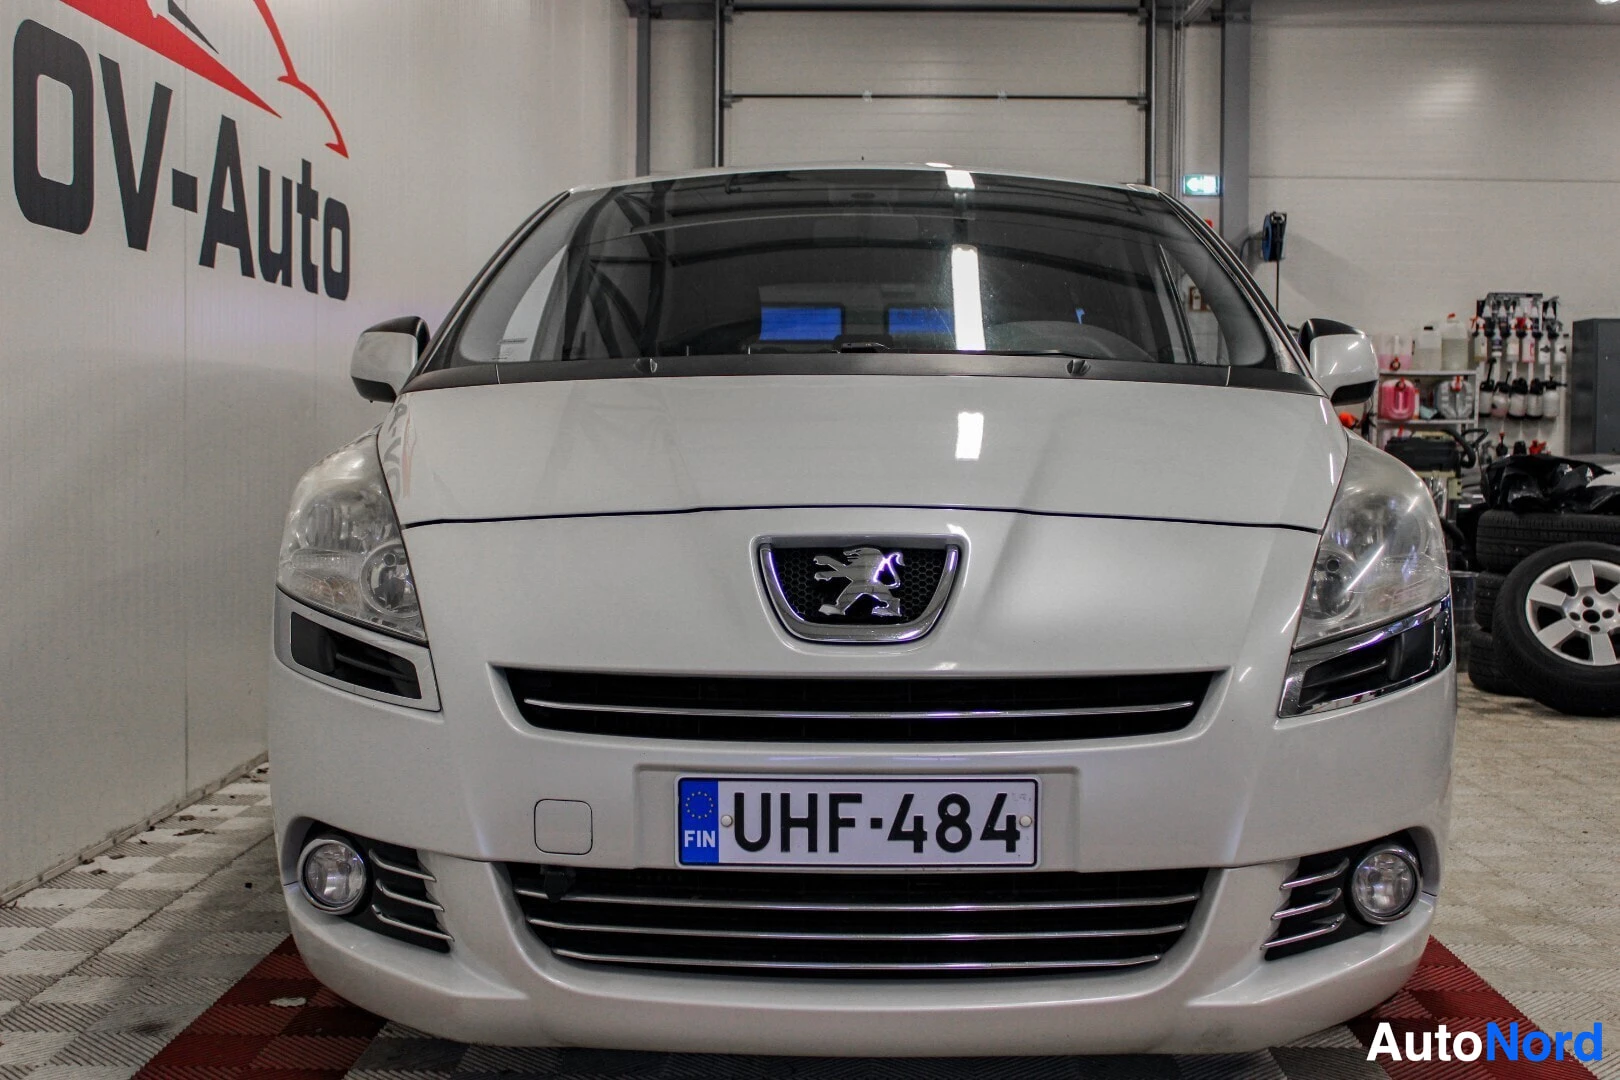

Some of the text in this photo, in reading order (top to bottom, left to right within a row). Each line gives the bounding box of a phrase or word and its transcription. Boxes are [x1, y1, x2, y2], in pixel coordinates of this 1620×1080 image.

[13, 19, 350, 301] OV-Auto
[683, 830, 716, 848] FIN
[734, 792, 1021, 853] UHF-484
